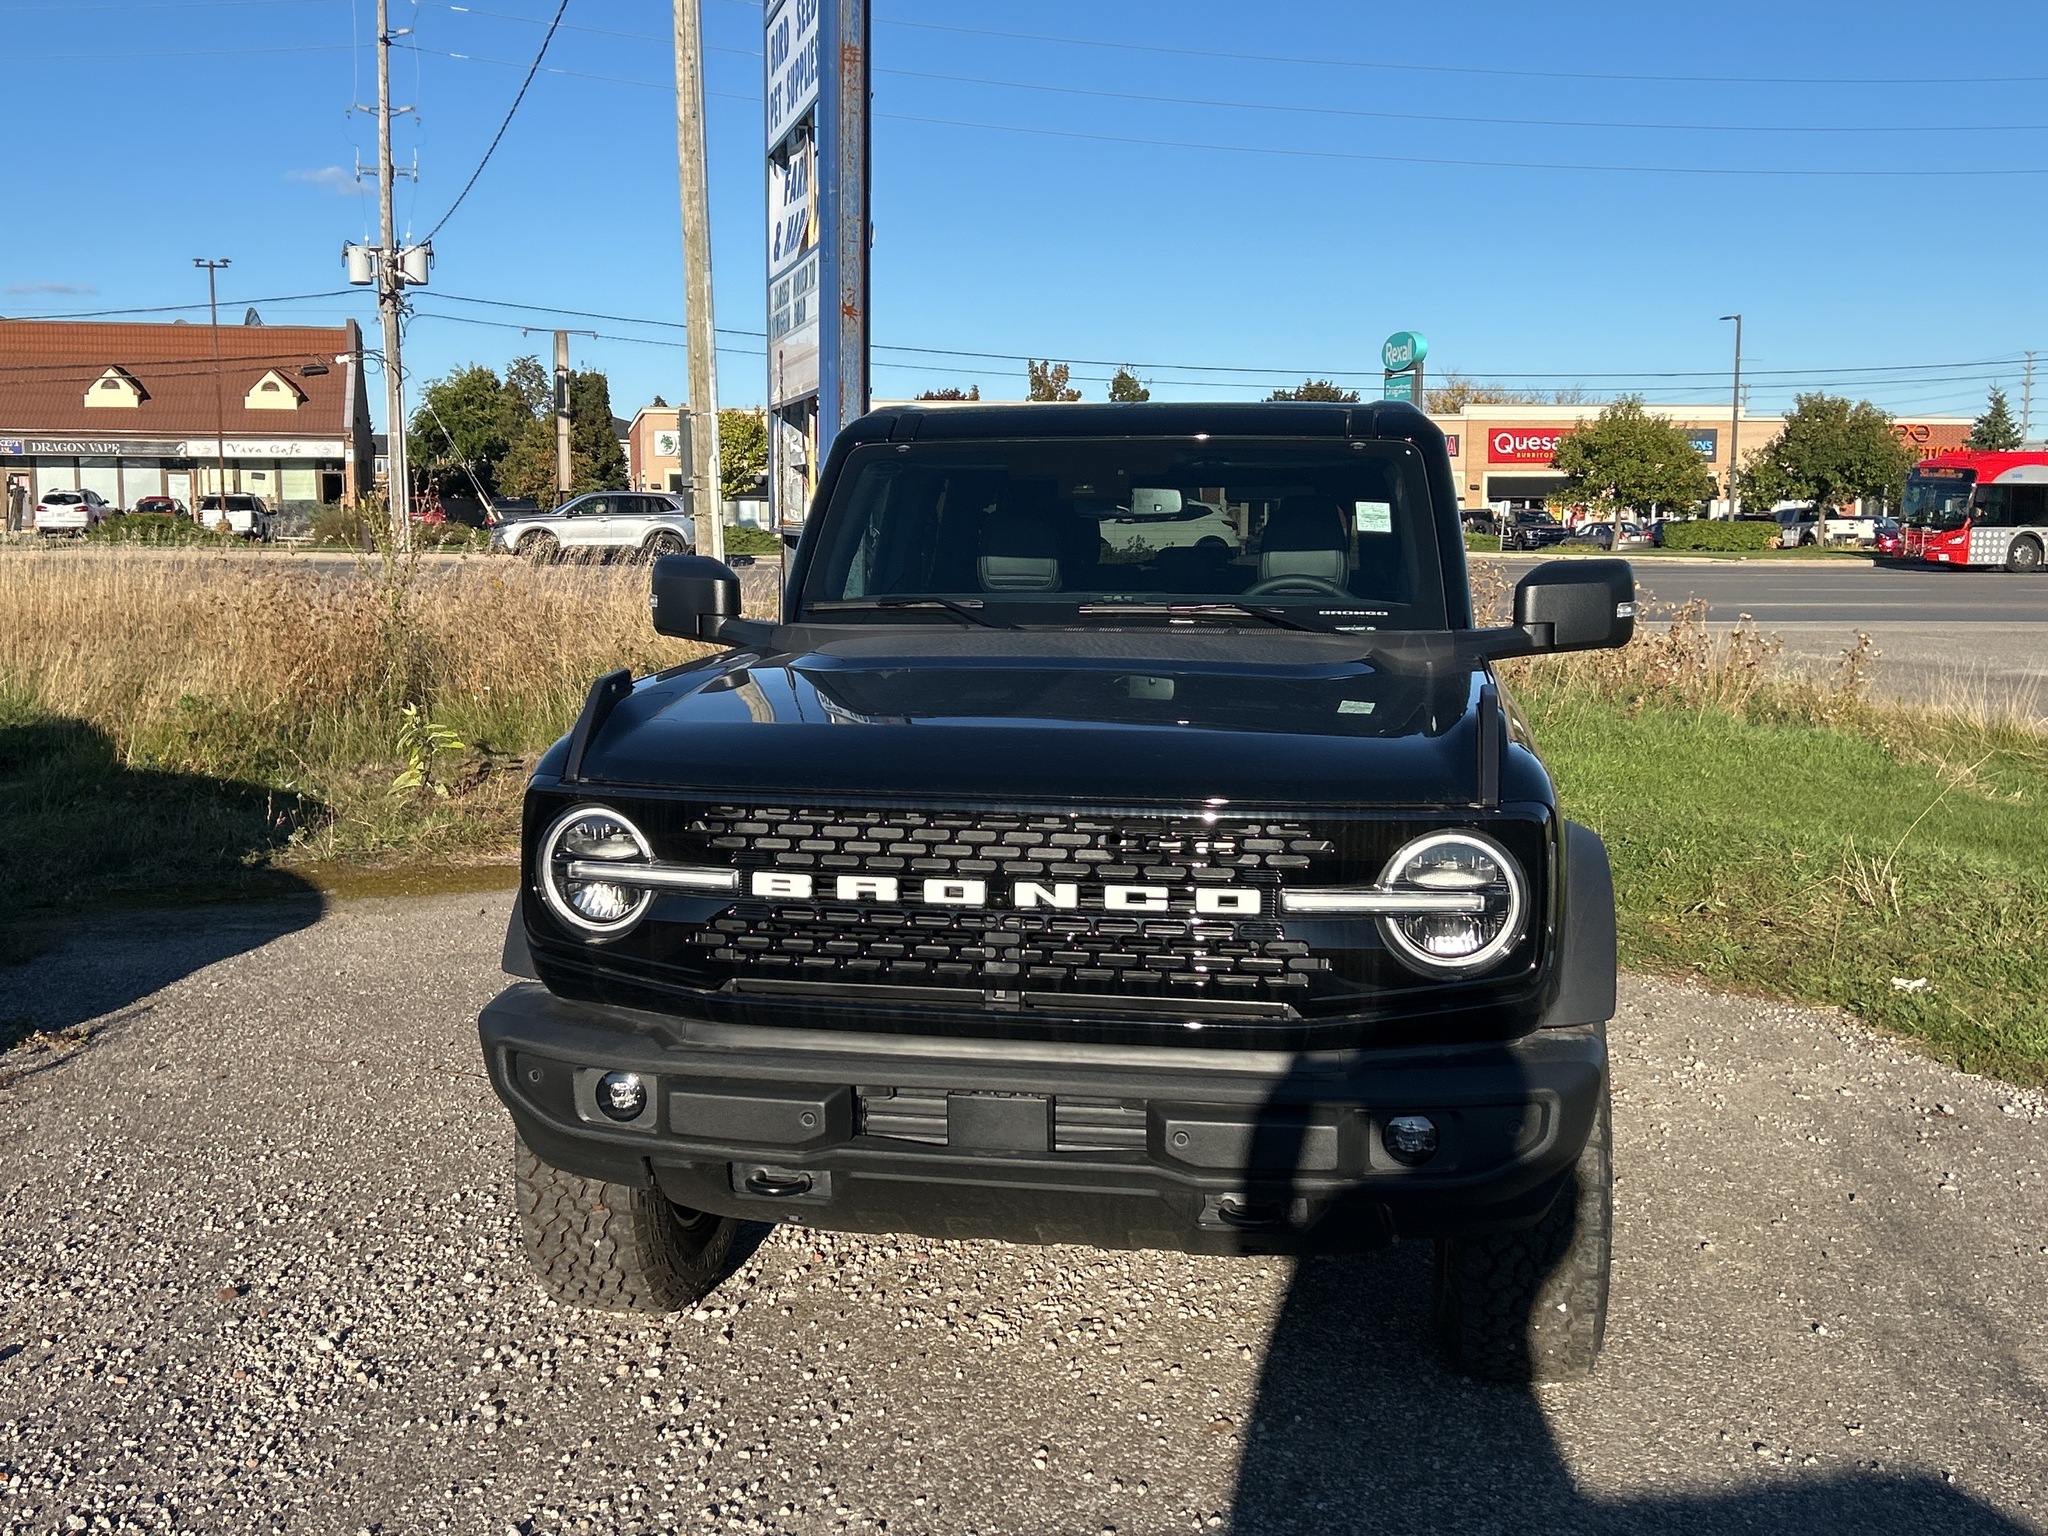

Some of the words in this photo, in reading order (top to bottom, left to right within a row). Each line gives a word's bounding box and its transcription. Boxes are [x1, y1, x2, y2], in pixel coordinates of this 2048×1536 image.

[770, 15, 789, 77] BIRD
[770, 81, 782, 134] PET
[786, 29, 819, 114] SUPPLIES
[774, 221, 782, 263] &
[1385, 338, 1413, 366] Rexall
[32, 442, 86, 453] DRAGON
[88, 443, 120, 454] VAPE
[226, 443, 263, 454] Viva
[269, 443, 302, 456] Café
[752, 871, 1261, 914] BRONCO
